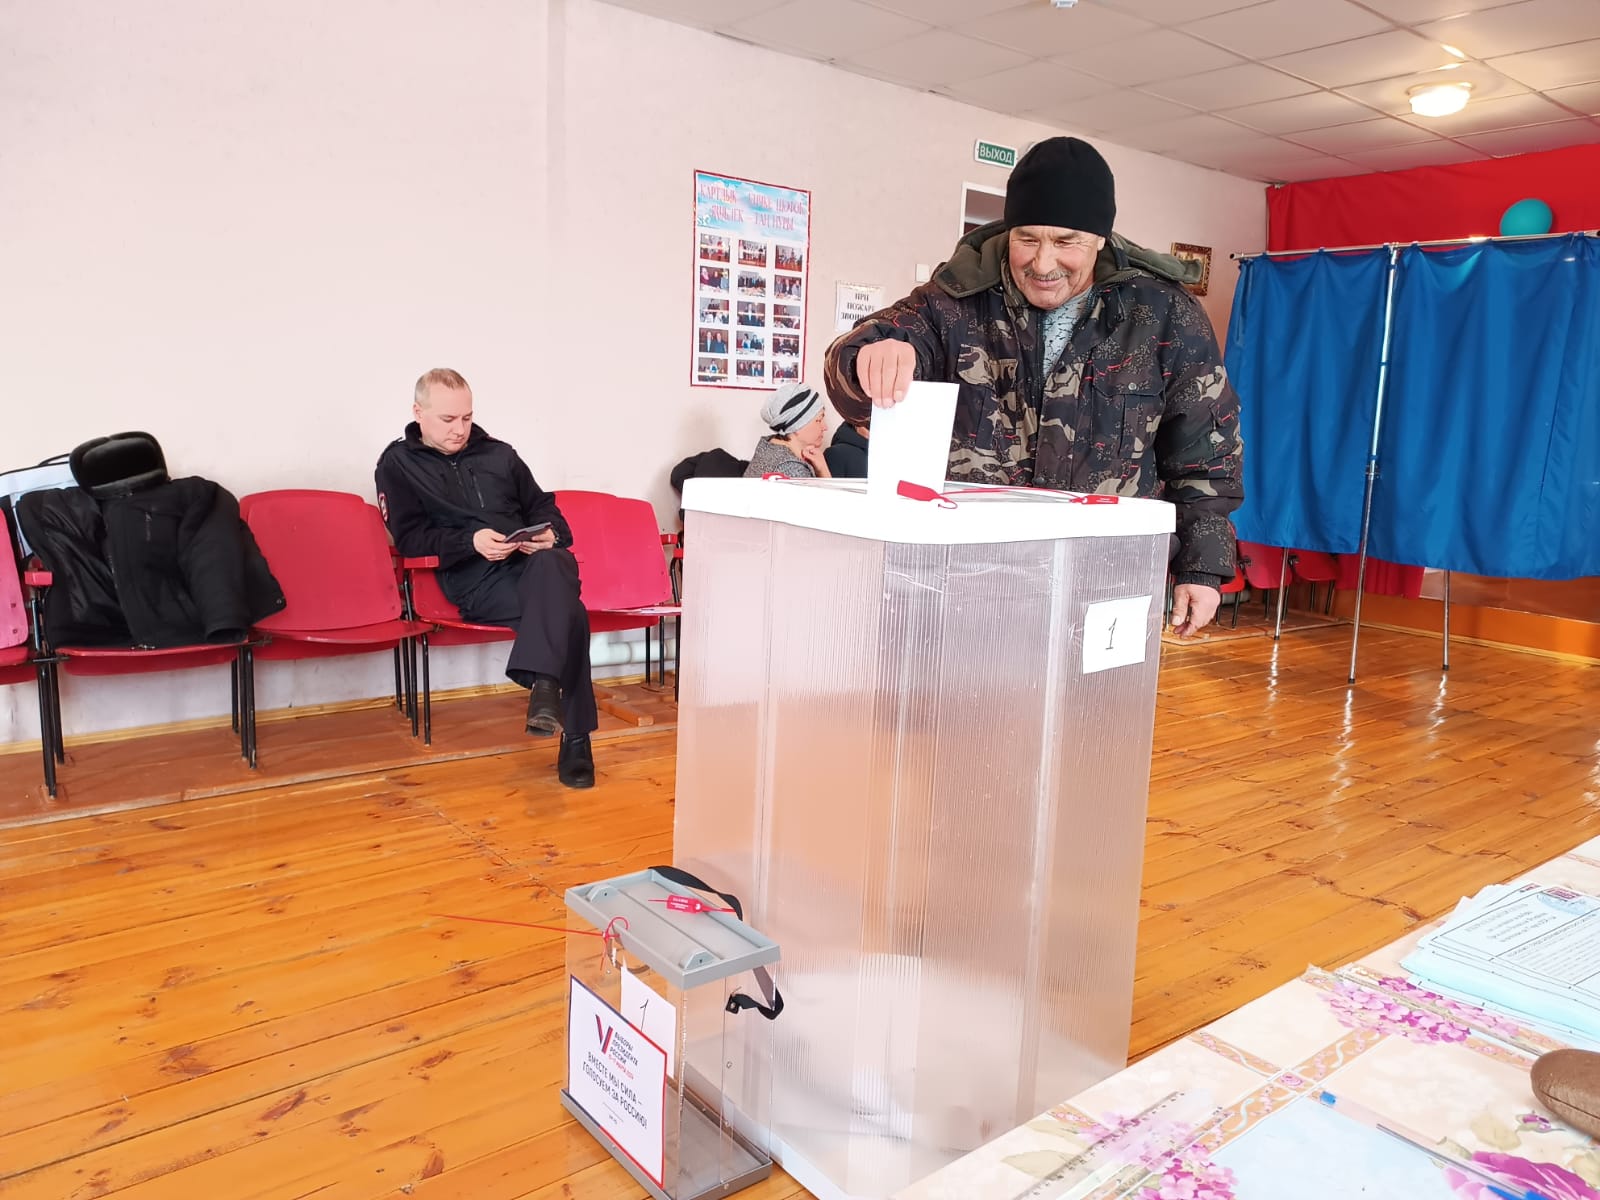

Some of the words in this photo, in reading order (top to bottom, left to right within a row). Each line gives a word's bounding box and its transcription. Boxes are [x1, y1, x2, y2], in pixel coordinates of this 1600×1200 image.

[980, 143, 1012, 164] ВЫХОД
[855, 293, 869, 301] ПРИ
[1105, 617, 1117, 650] 1
[640, 999, 649, 1032] 1
[609, 1046, 627, 1065] РОССИИ
[611, 1039, 639, 1067] ПРЕЗИДЕНТА
[614, 1031, 634, 1052] ВЫБОРЫ
[588, 1051, 608, 1079] ВМЕСТЕ
[608, 1072, 620, 1089] МЫ
[620, 1082, 637, 1105] СИЛА
[582, 1061, 611, 1096] ГОЛОСУЕМ
[611, 1088, 620, 1102] ЗА
[619, 1096, 648, 1129] РОССИЮ!
